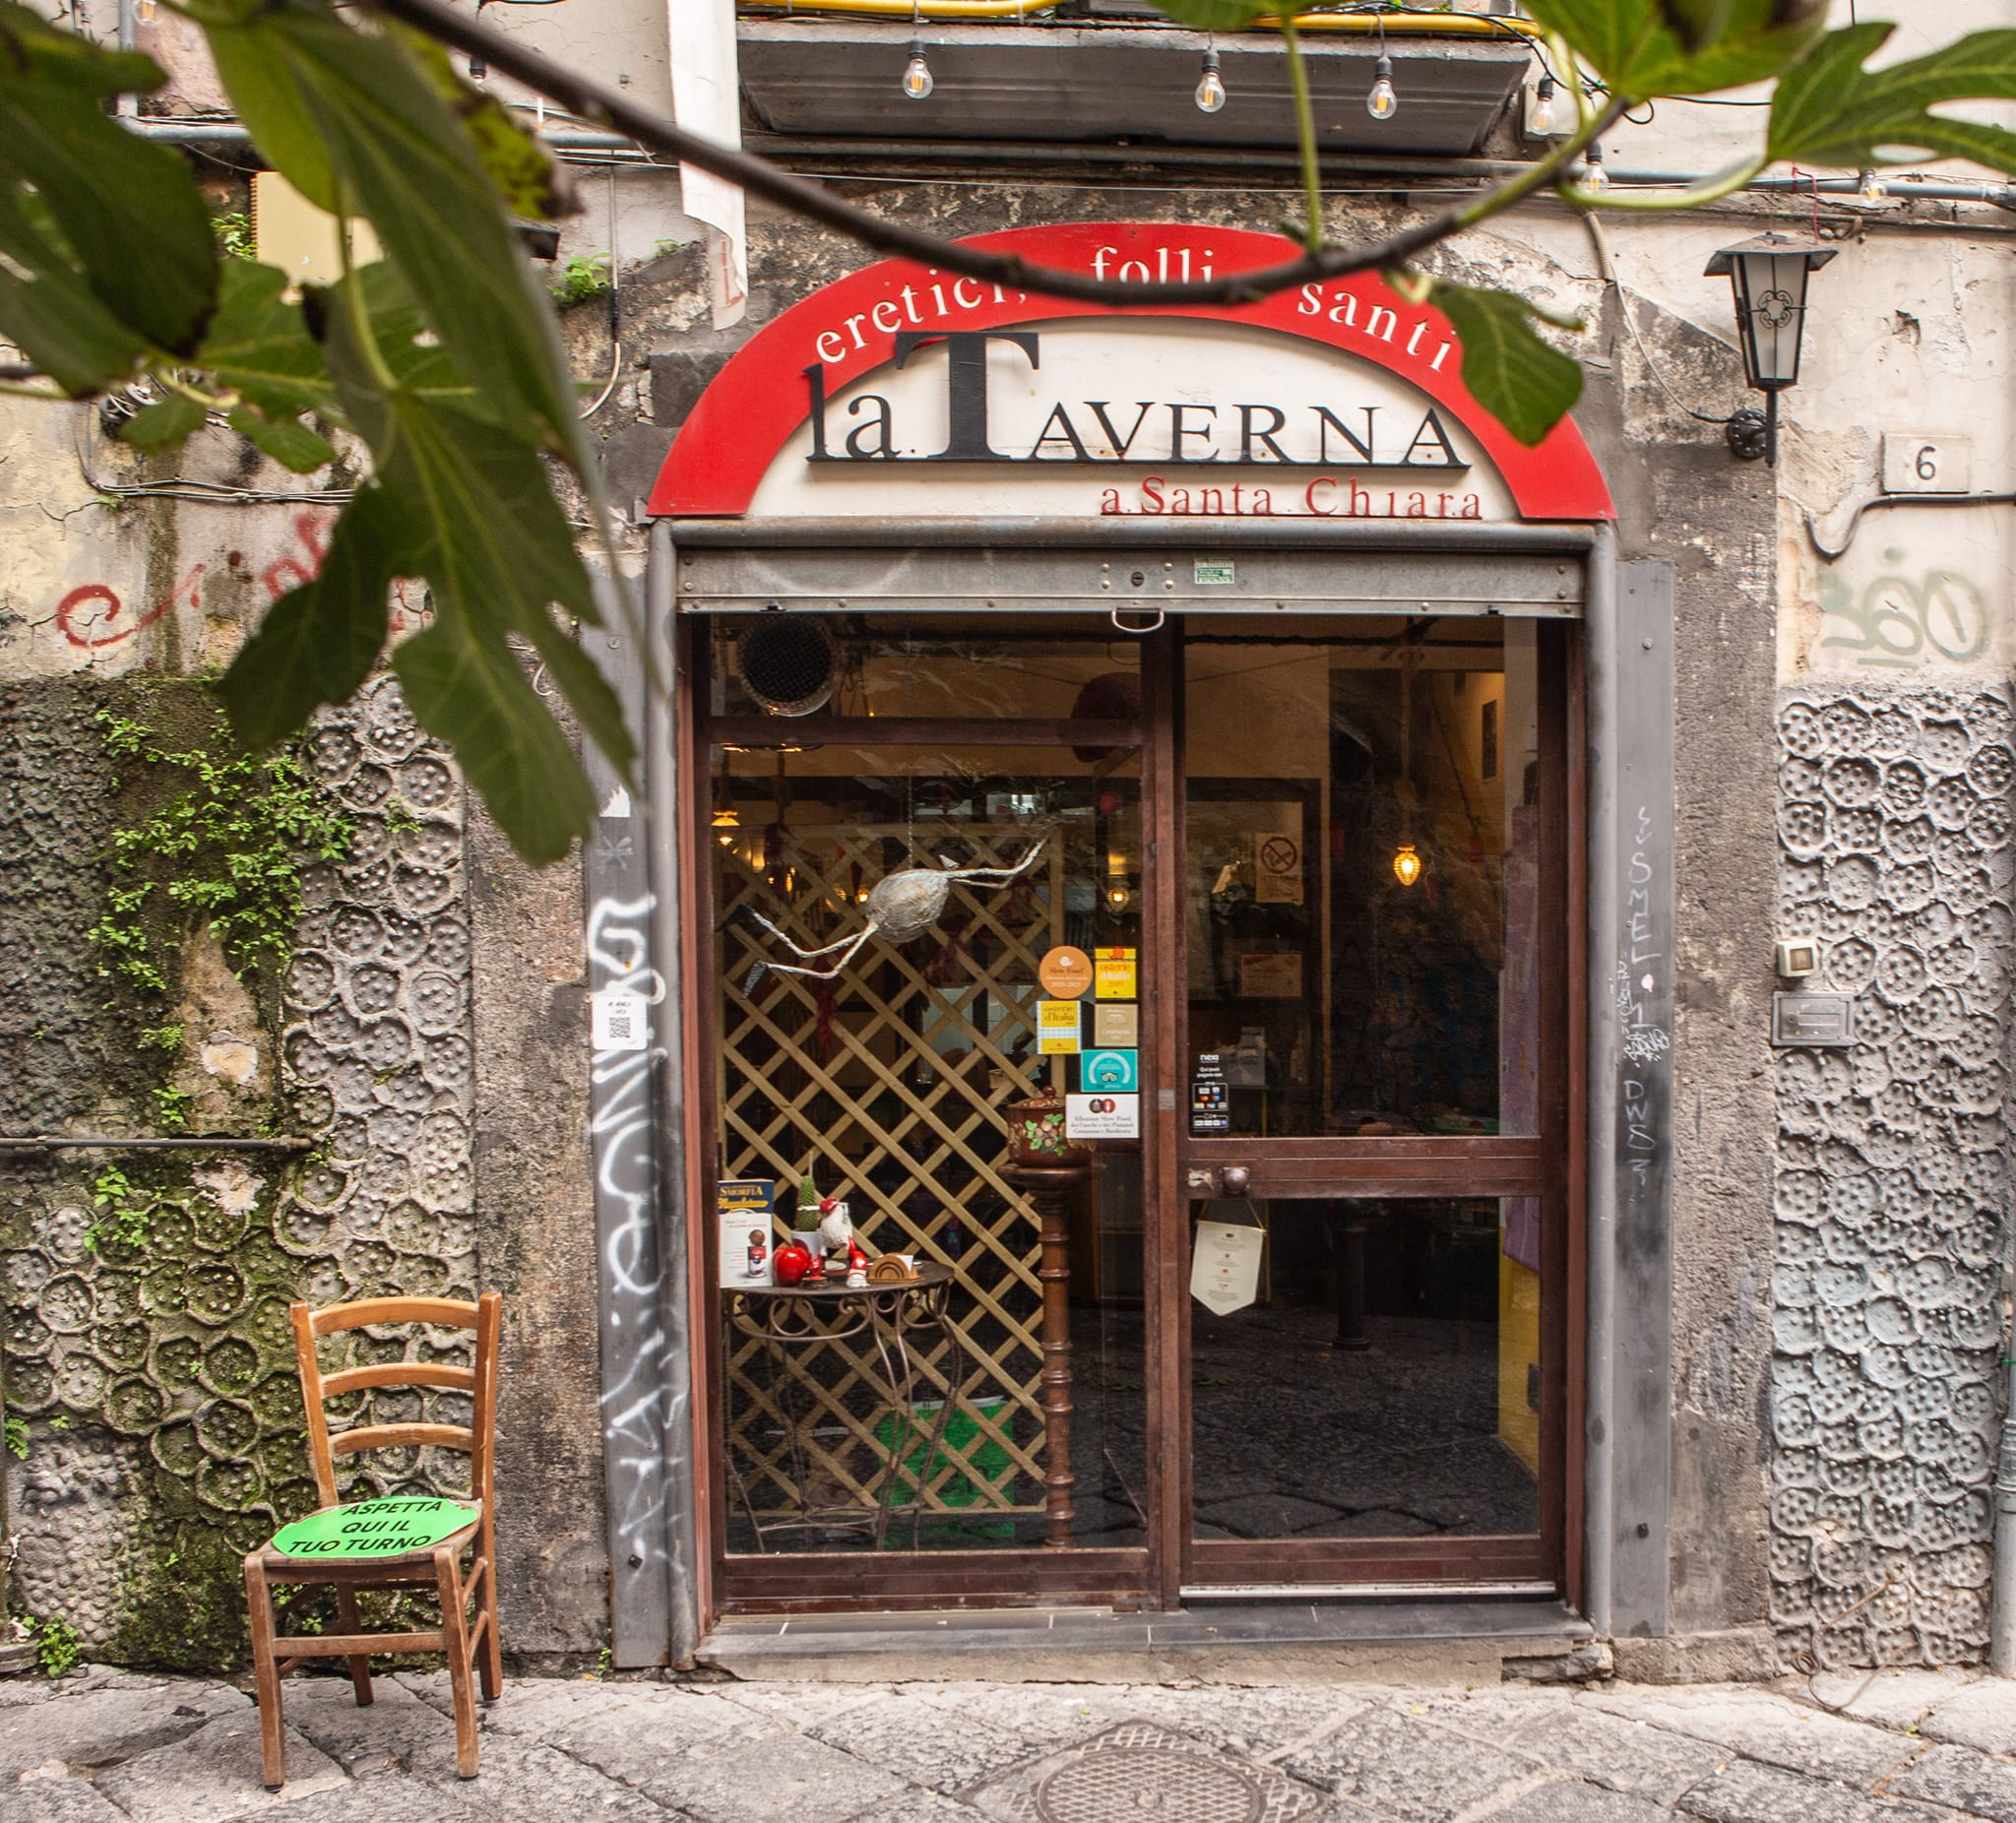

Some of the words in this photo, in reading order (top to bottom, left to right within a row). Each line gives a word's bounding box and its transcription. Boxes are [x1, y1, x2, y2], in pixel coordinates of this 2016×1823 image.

[1090, 246, 1214, 284] folli
[1297, 283, 1457, 372] santi
[801, 362, 902, 463] la
[895, 331, 1473, 469] TAVERNA
[1916, 445, 1937, 480] 6
[1140, 474, 1274, 517] Santa
[1305, 476, 1482, 520] Chiara
[341, 1501, 443, 1516] ASPETTA
[287, 1540, 340, 1553] TUO
[345, 1536, 431, 1551] TURNO
[342, 1521, 390, 1534] QUI
[391, 1520, 410, 1532] IL
